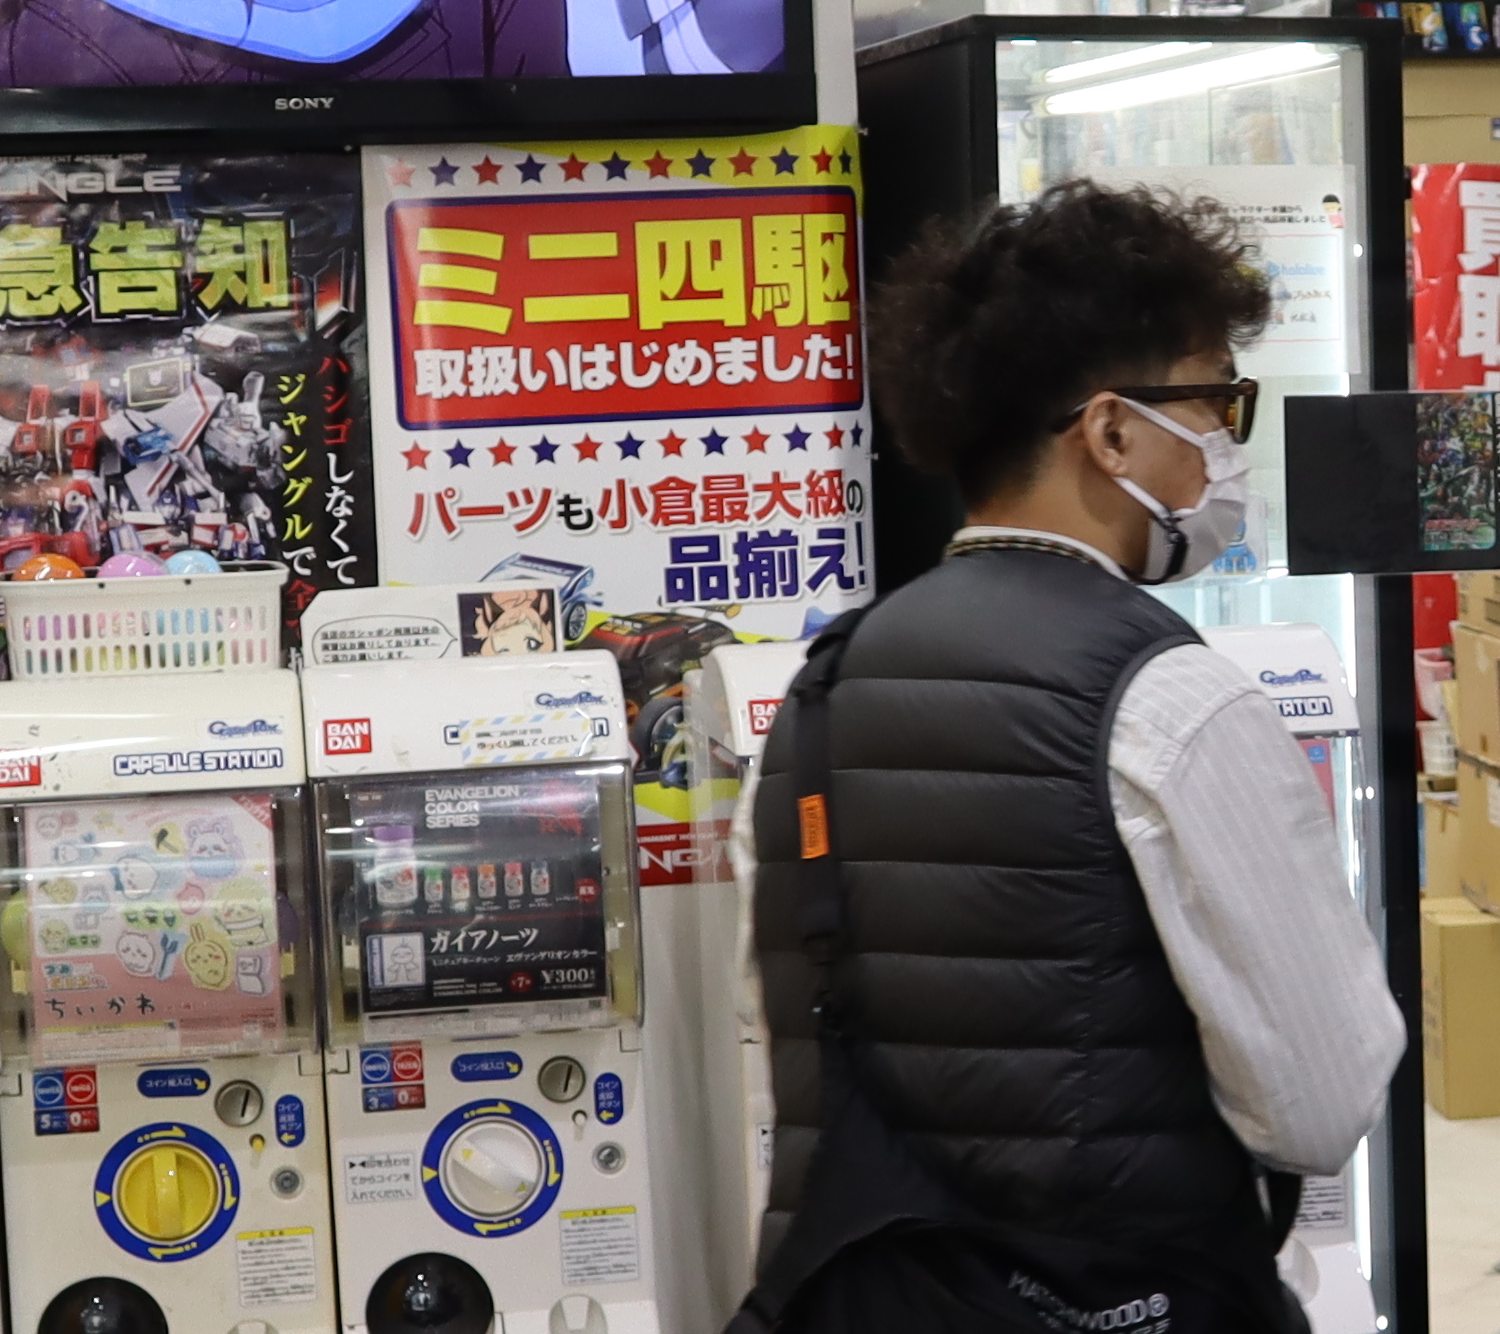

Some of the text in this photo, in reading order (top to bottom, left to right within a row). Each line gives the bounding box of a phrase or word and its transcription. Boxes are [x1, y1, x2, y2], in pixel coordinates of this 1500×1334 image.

[274, 97, 335, 110] SONY
[412, 212, 852, 336] ミニ四駆
[413, 332, 856, 402] 取扱いはじめました!
[317, 356, 359, 586] ハシゴしなくて
[407, 468, 863, 539] パーツも小倉最大級の
[664, 523, 868, 605] 品揃え!
[326, 722, 370, 737] BAN
[327, 736, 363, 749] DAI
[113, 747, 284, 776] CAPSULE STATION
[425, 785, 521, 801] EVANGELION
[425, 801, 480, 816] COLOR
[425, 815, 480, 829] SERIES
[429, 927, 540, 954] ガイアノーツ
[44, 994, 156, 1019] ちいかわ
